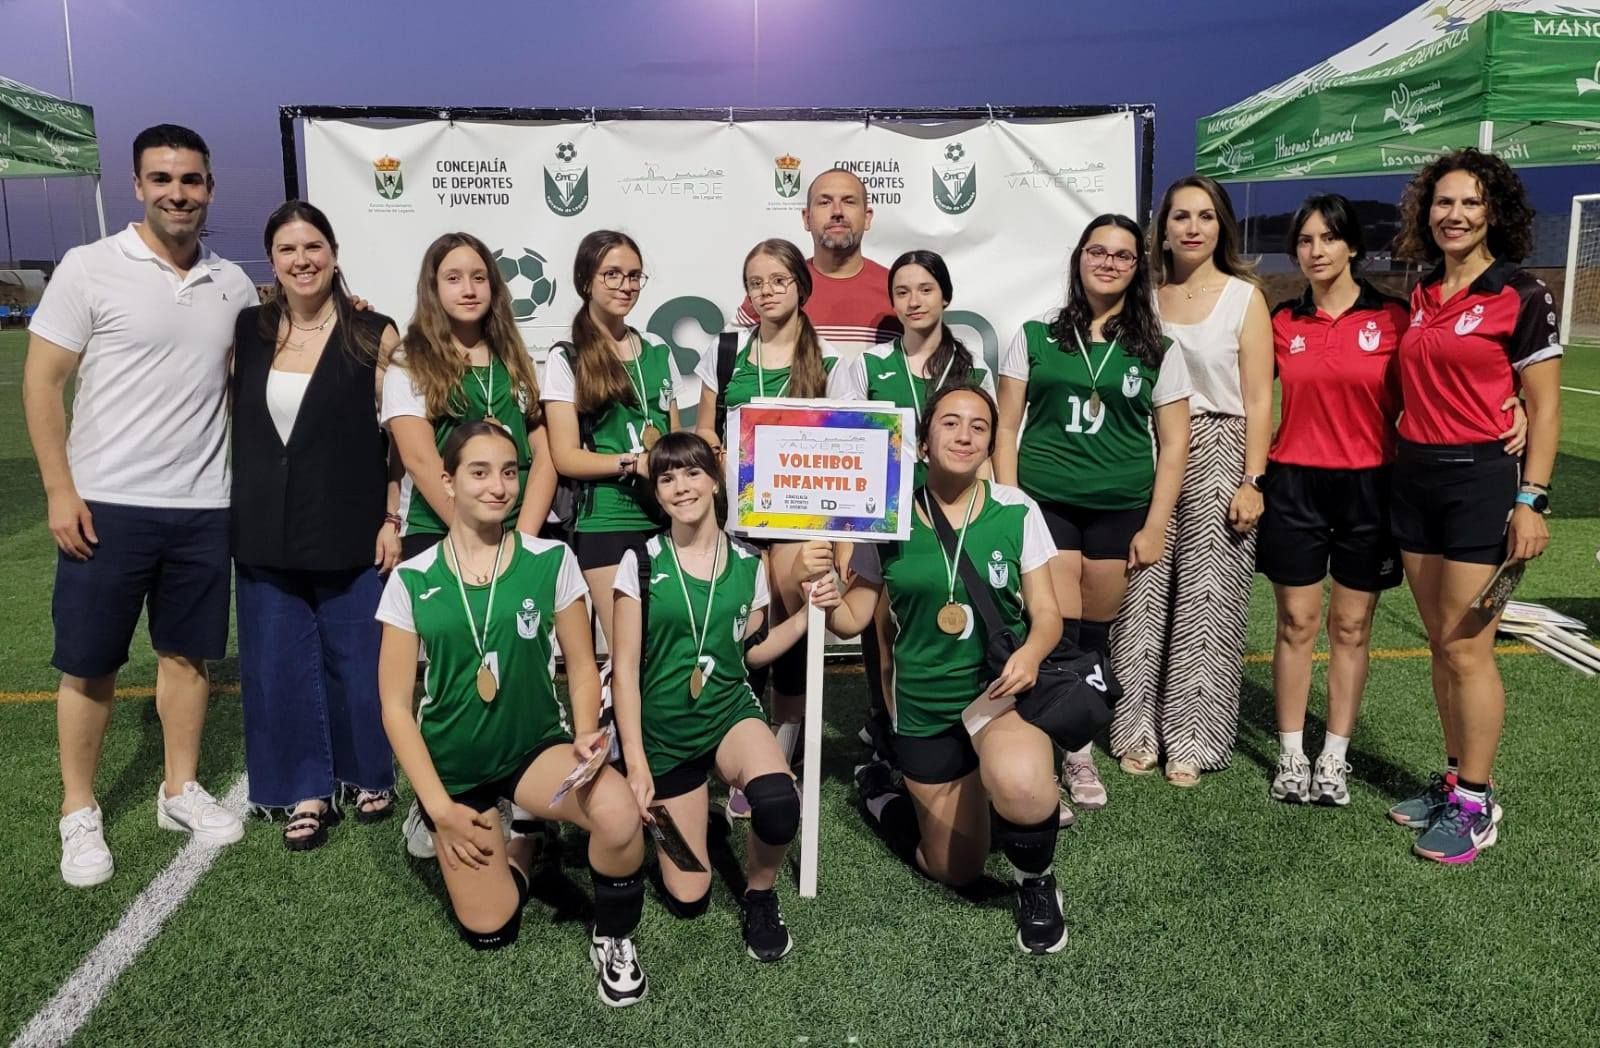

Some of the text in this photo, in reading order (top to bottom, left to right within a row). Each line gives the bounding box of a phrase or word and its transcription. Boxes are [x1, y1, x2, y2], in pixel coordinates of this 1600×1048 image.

[436, 157, 507, 175] CONCEJALÍA
[432, 177, 513, 189] DE DEPORTES
[621, 182, 724, 195] VALVERDE
[1008, 175, 1105, 189] VALVERDE
[437, 193, 510, 207] Y JUVENTUD
[1065, 395, 1106, 434] 19
[779, 453, 863, 470] VOLEIBOL
[773, 474, 868, 492] INFANTIL B
